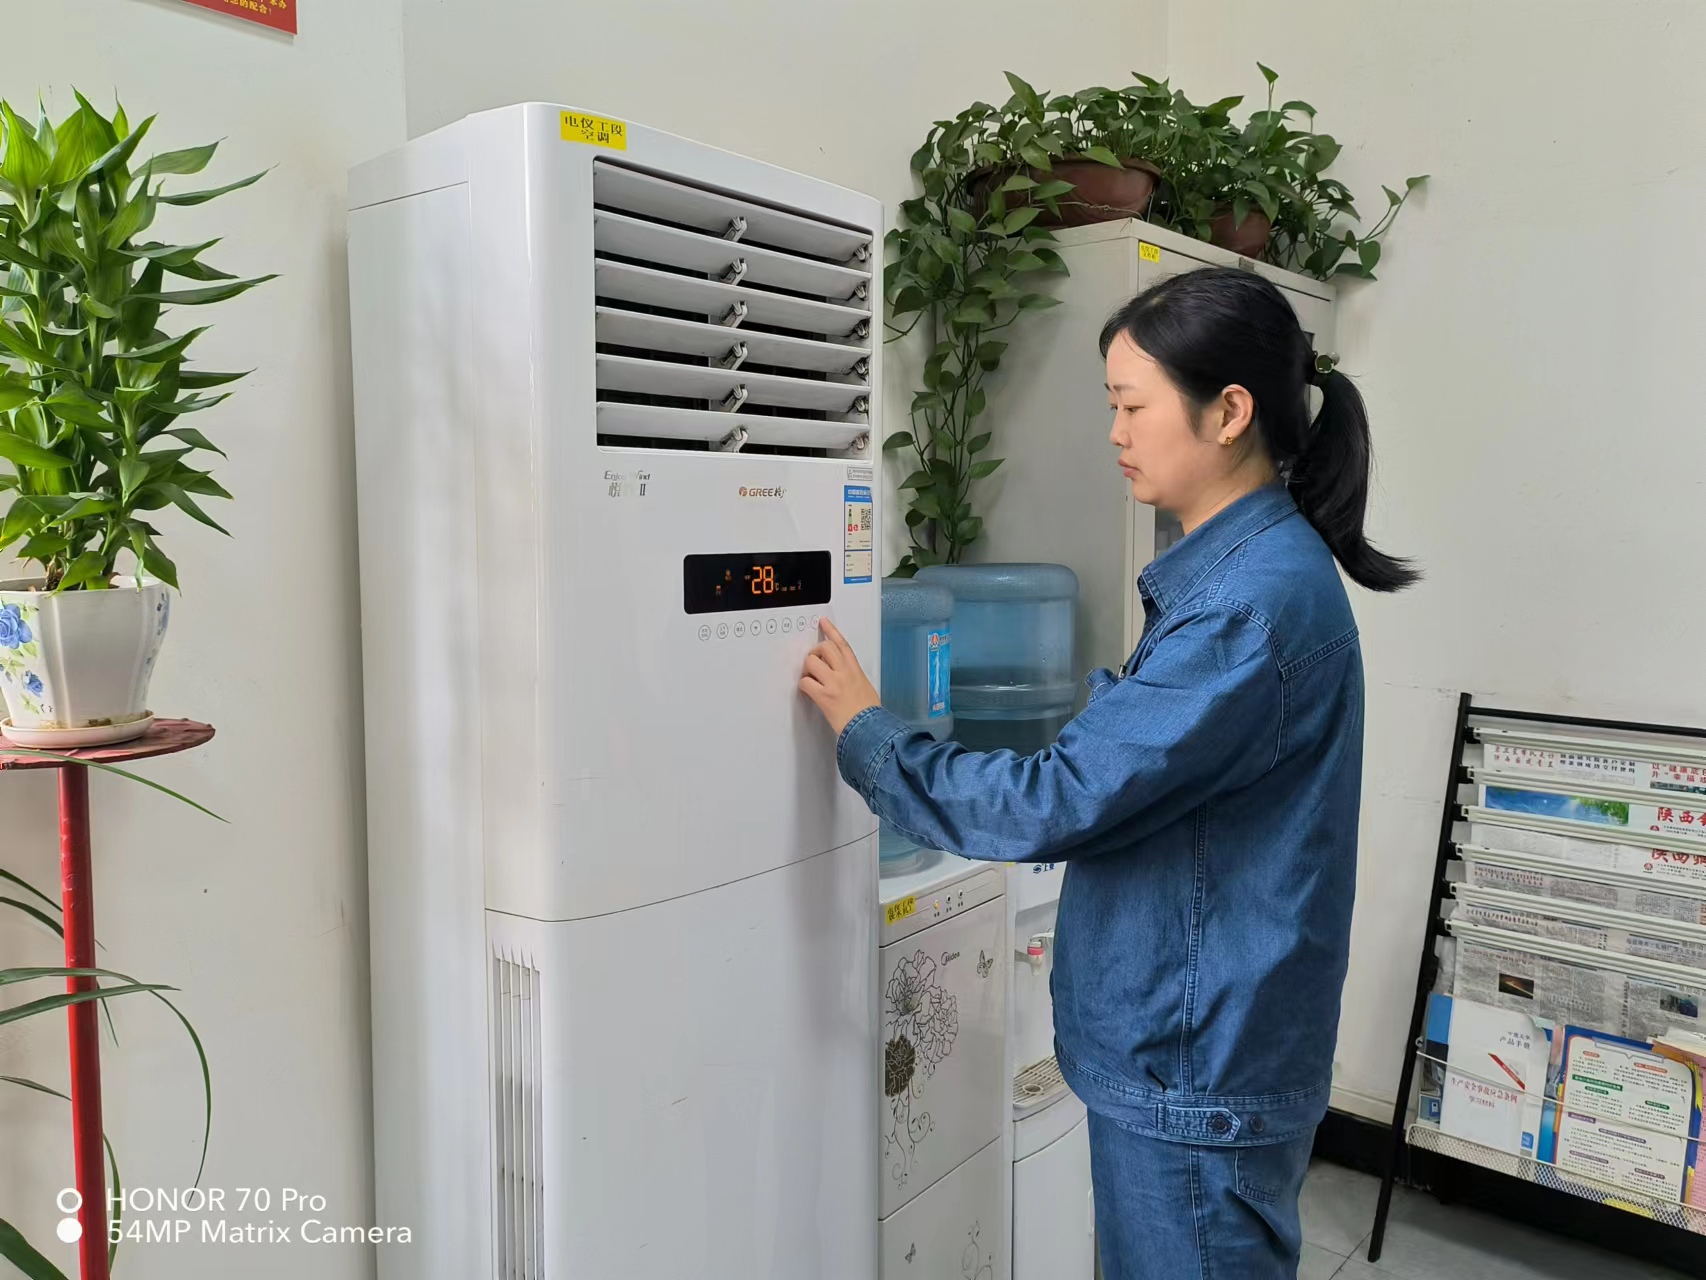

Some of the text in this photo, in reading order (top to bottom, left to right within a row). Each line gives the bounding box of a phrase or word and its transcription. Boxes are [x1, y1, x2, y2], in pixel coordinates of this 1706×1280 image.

[564, 115, 623, 136] 电仪工段
[580, 128, 610, 144] 空调
[748, 487, 774, 497] GREE
[752, 566, 774, 594] 28
[941, 951, 961, 966] Midea
